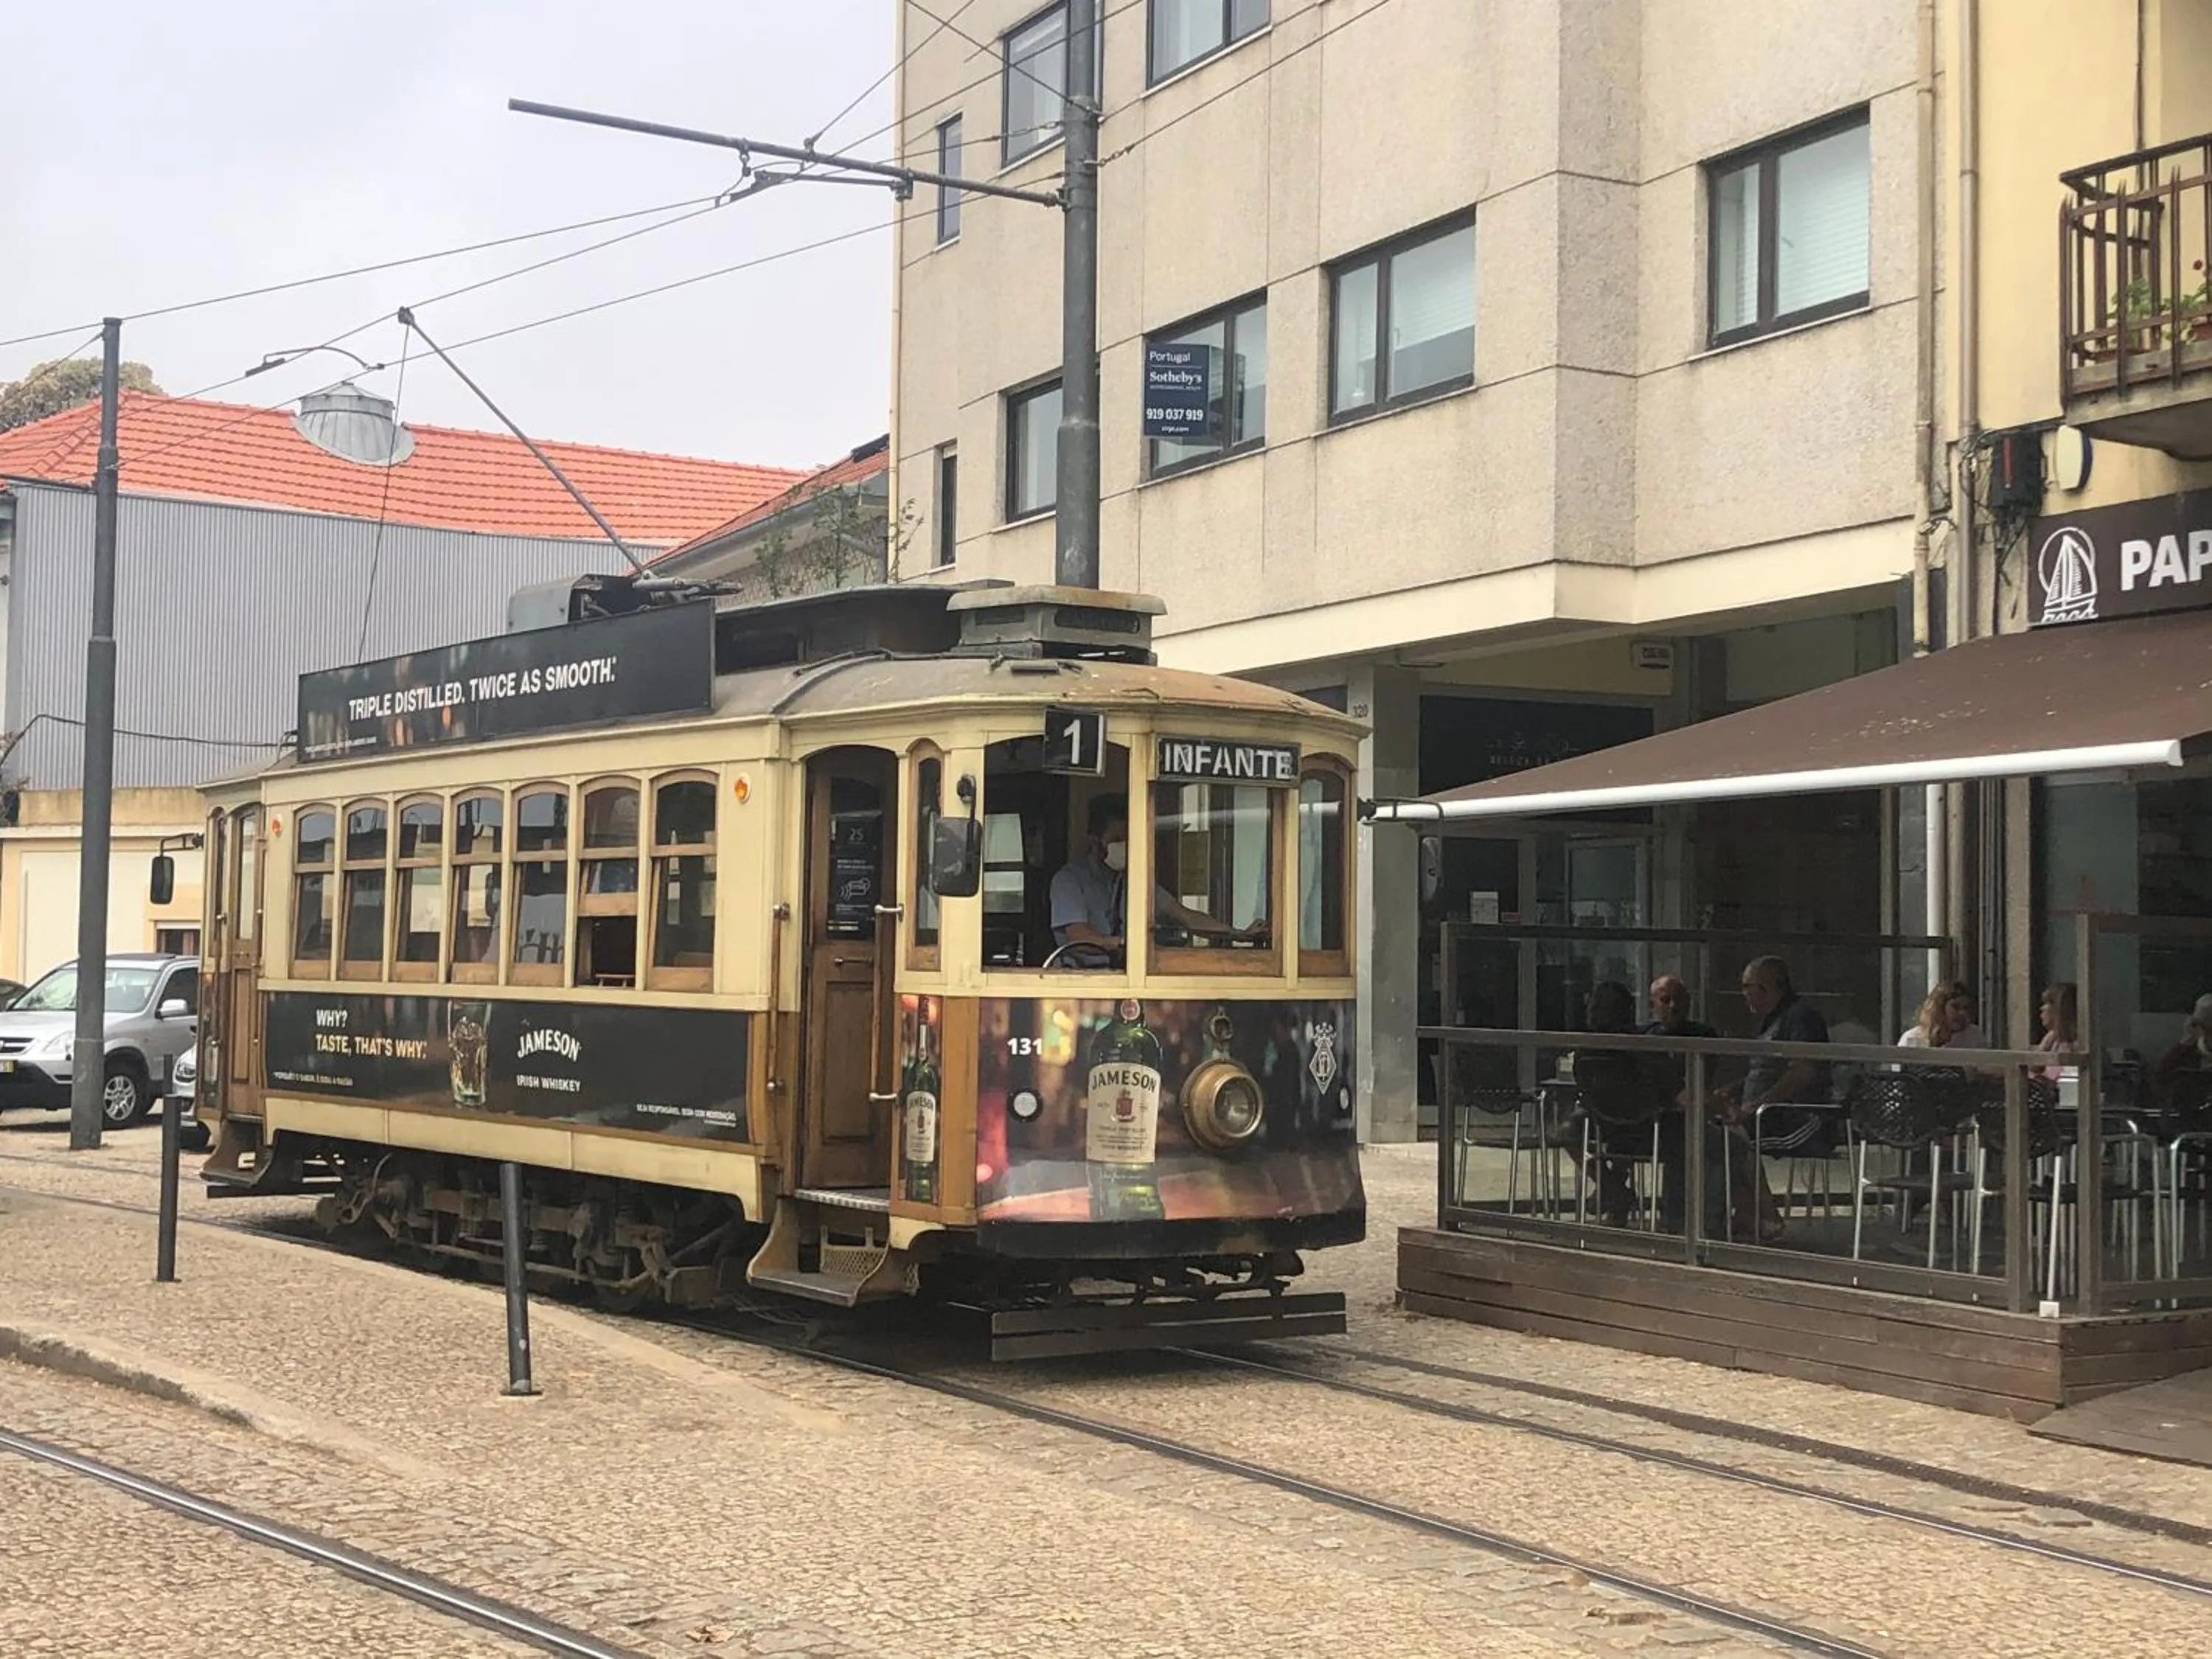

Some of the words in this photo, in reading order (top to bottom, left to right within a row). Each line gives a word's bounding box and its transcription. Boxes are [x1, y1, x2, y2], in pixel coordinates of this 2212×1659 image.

[1150, 351, 1191, 364] Portugal
[1150, 370, 1203, 385] Sotheby's
[1147, 408, 1164, 420] 919
[1166, 408, 1183, 420] 037
[1186, 409, 1204, 421] 919
[2121, 529, 2212, 591] PAP
[349, 692, 392, 721] TRIPLE
[394, 684, 465, 716] DISTILLED.
[469, 672, 516, 703] TWICE
[520, 668, 541, 694] AS
[1063, 719, 1082, 765] 1
[1164, 742, 1293, 780] INFANTE
[316, 1009, 348, 1027] WHY?
[316, 1034, 352, 1056] TASTE,
[354, 1037, 393, 1057] THAT'S
[517, 1029, 580, 1062] JAMESON
[1007, 1037, 1042, 1055] 131
[517, 1074, 539, 1088] IRISH
[541, 1077, 581, 1093] WHISKEY
[1091, 1070, 1157, 1093] JAMESON
